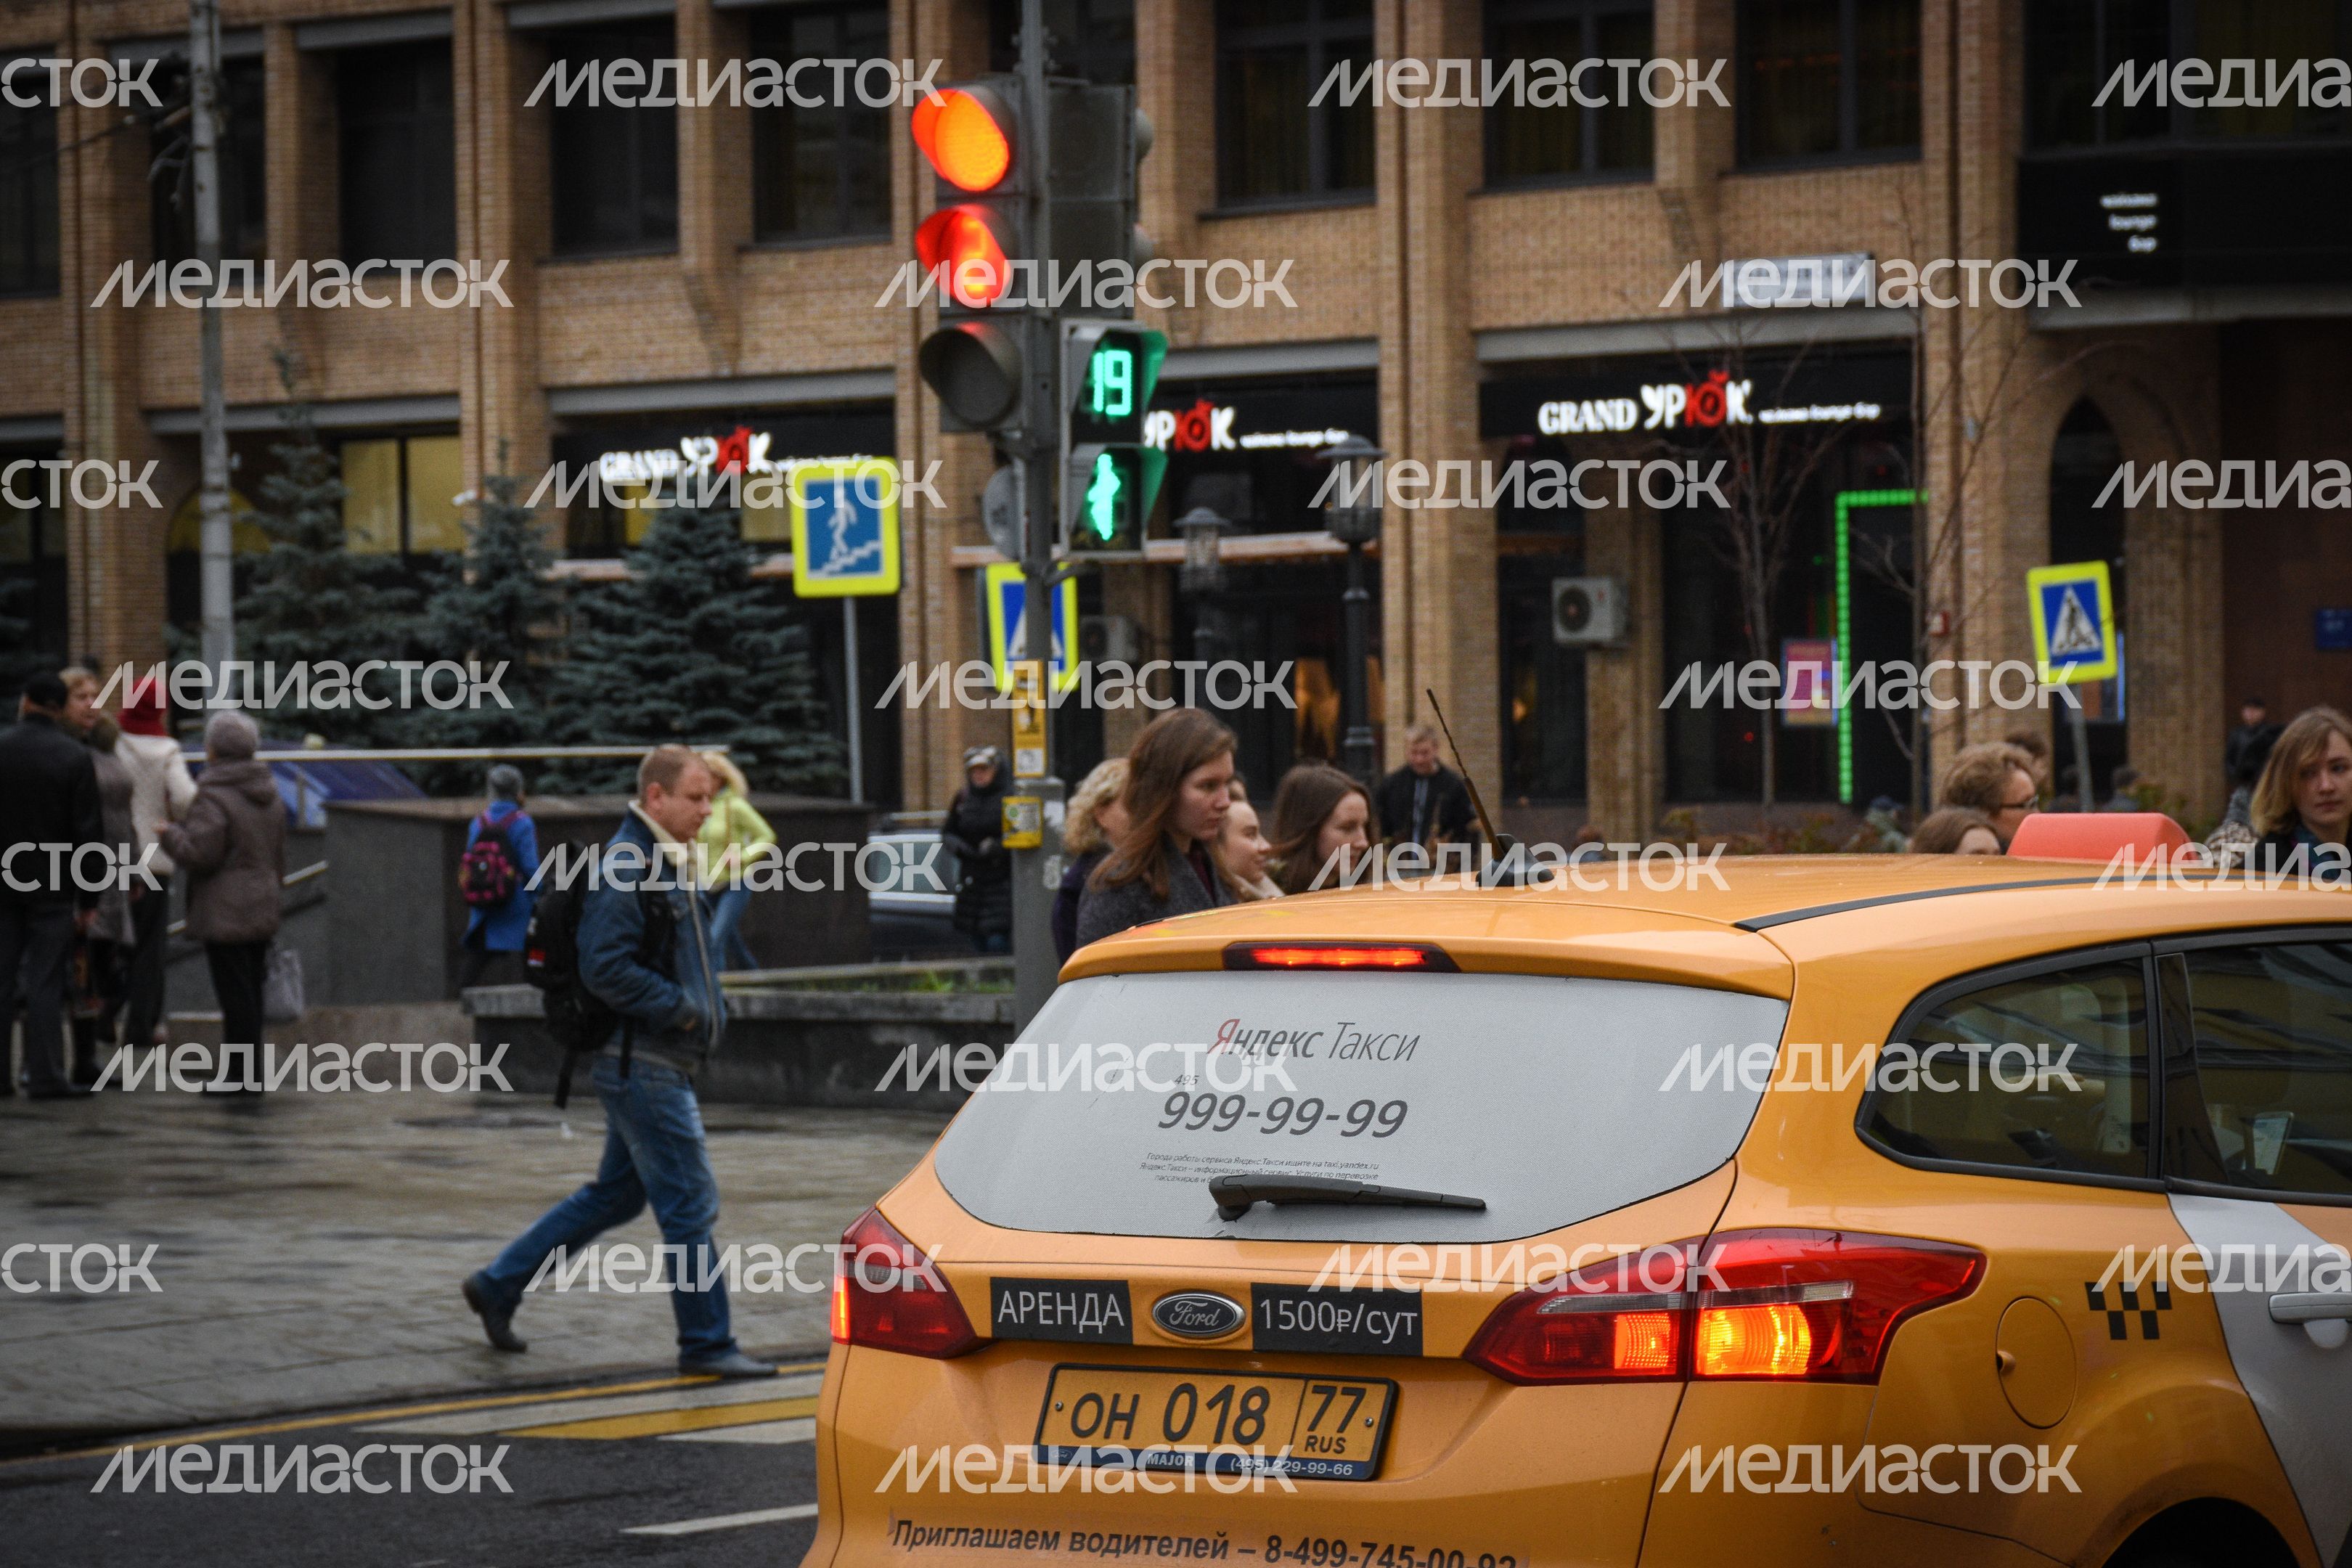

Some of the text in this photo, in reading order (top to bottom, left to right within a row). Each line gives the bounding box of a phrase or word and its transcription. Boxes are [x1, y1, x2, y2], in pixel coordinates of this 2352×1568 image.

[1093, 350, 1132, 415] 19
[1538, 399, 1638, 435] GRAND
[1641, 370, 1752, 429] УРЮК
[1208, 1018, 1421, 1061] Яндекс Такси
[1174, 1074, 1199, 1085] 495
[1158, 1091, 1408, 1138] 999-99-99
[997, 1291, 1124, 1334] АРЕНДА
[1168, 1299, 1221, 1327] Ford
[1259, 1298, 1418, 1344] 1500₽/сут
[1164, 1383, 1270, 1445] 018
[1307, 1385, 1367, 1433] 77
[1147, 1453, 1194, 1467] MAJOR
[1273, 1461, 1353, 1476] 229-99-66
[1304, 1434, 1347, 1454] RUS
[893, 1519, 1060, 1551] Приглашаем
[1069, 1531, 1229, 1560] водителей
